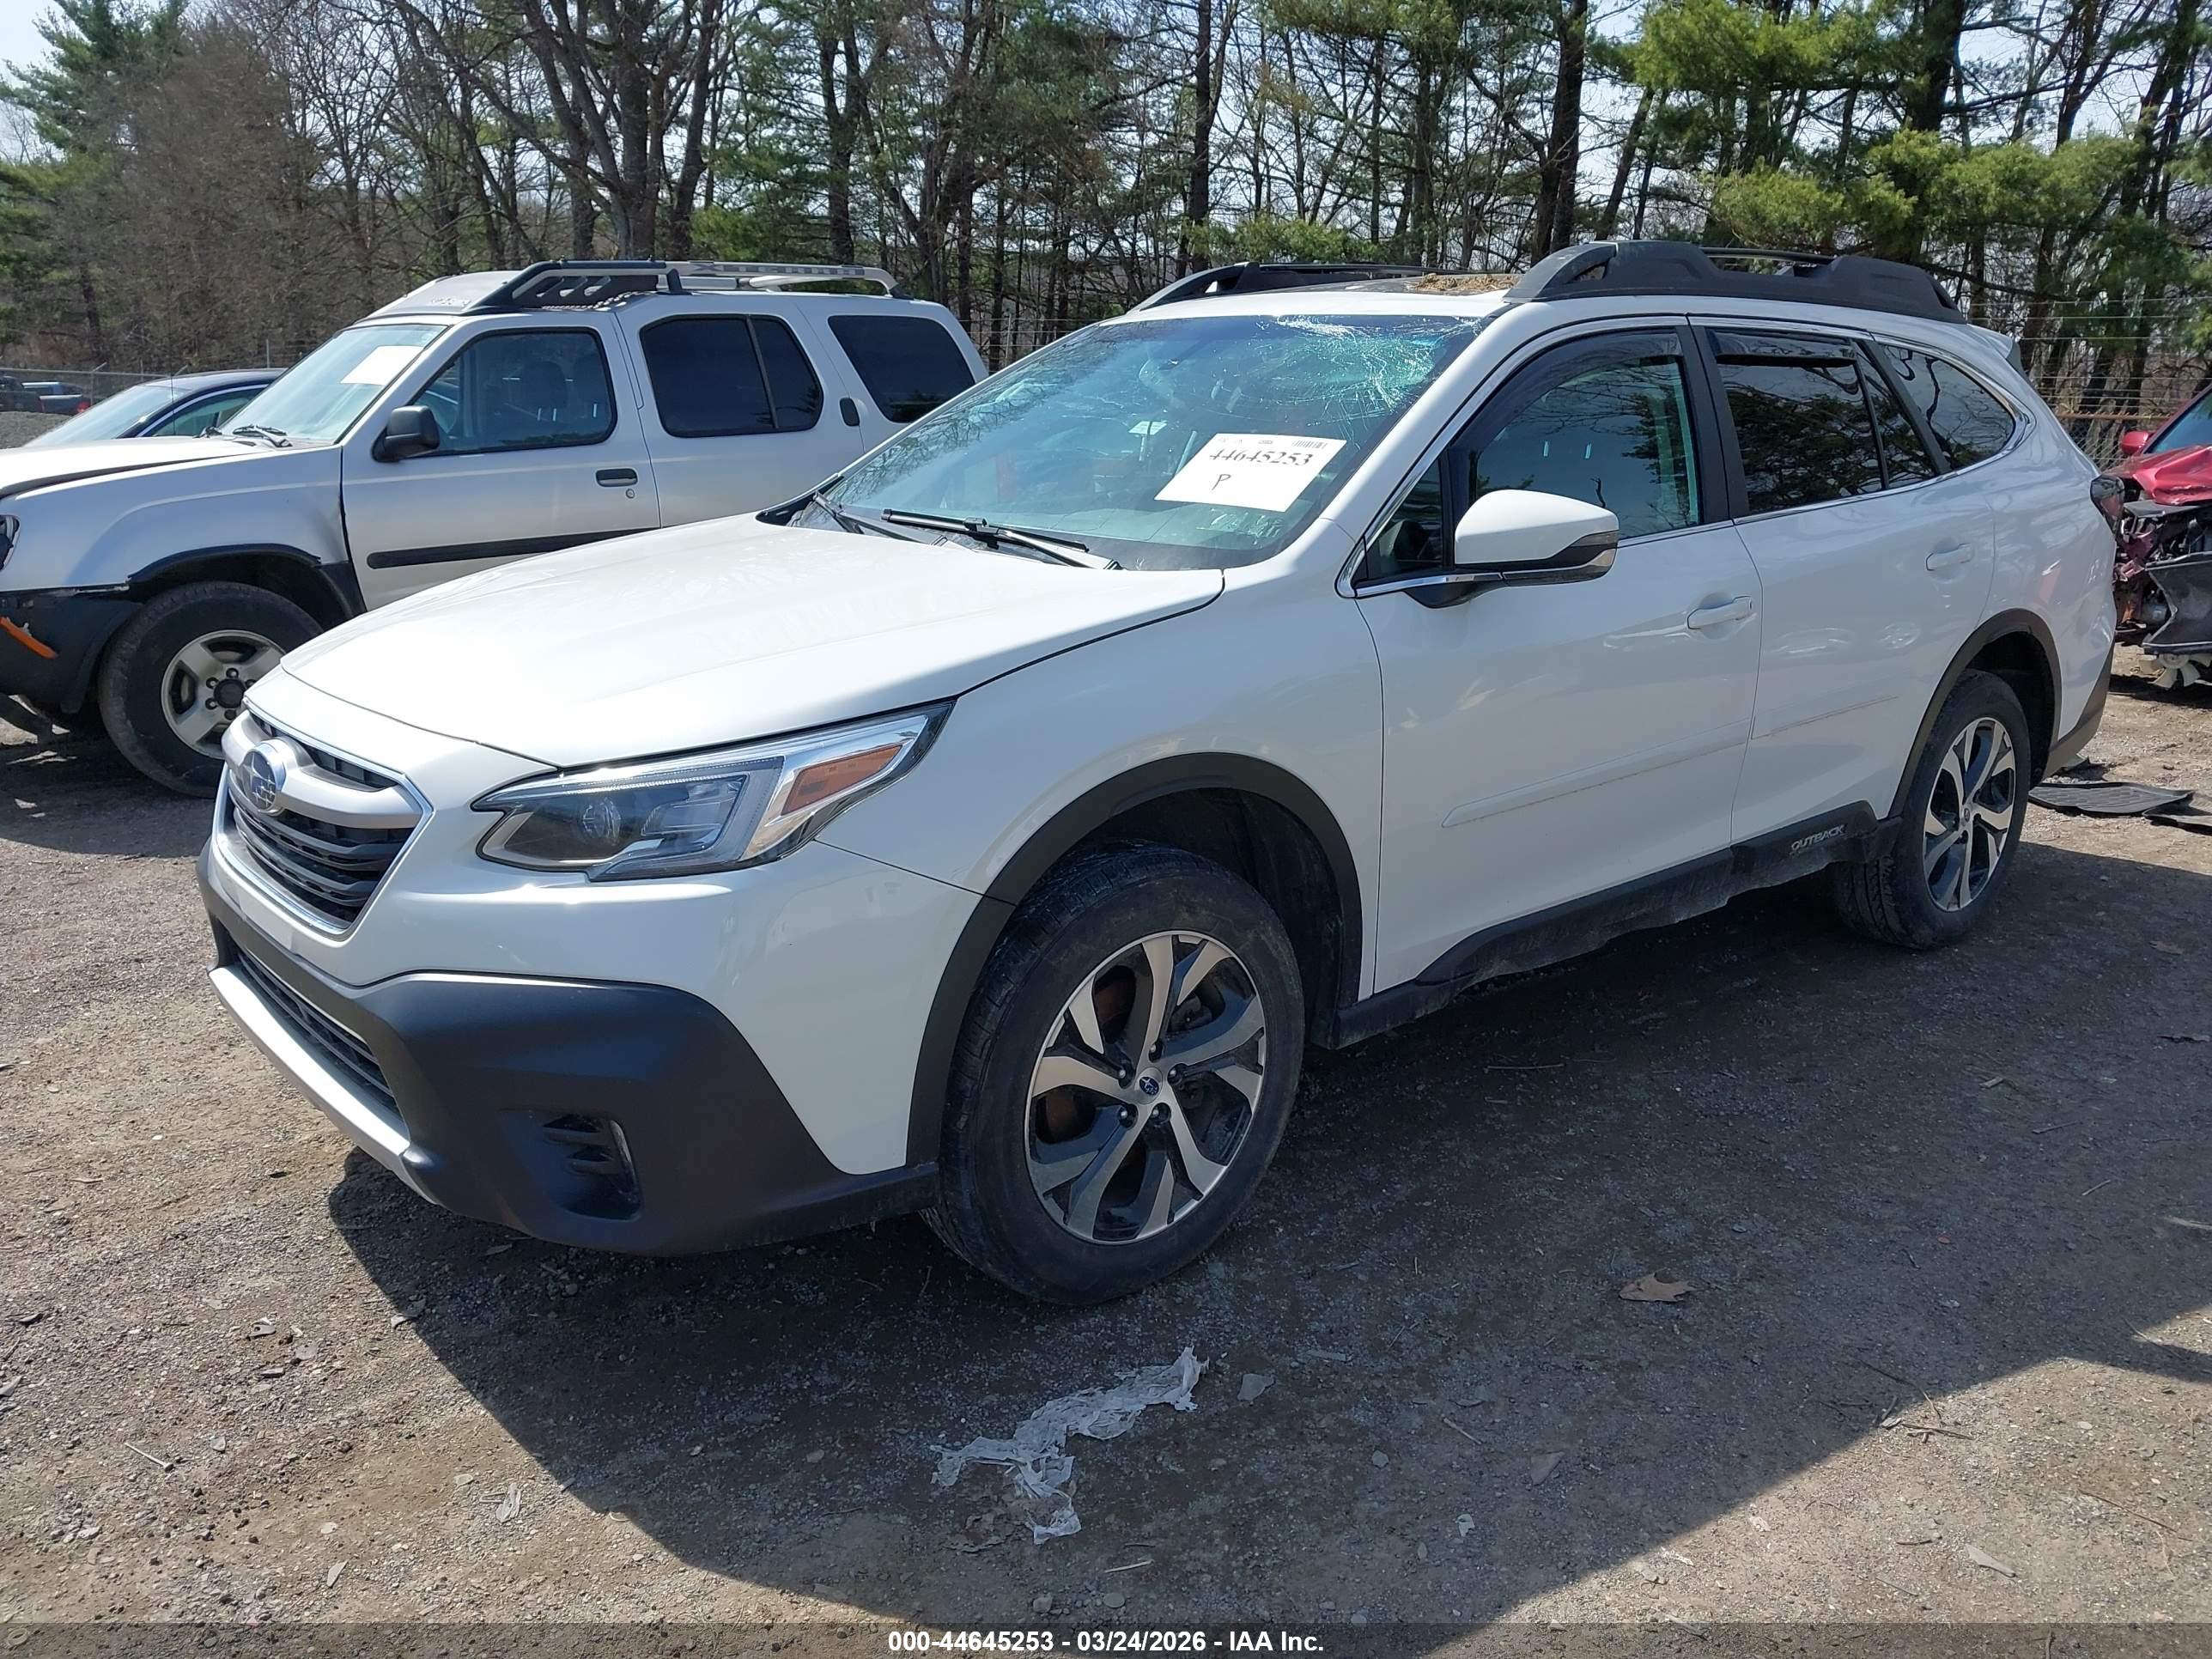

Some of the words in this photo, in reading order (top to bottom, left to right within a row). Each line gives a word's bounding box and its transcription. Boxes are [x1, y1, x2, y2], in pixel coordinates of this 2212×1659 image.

[1209, 448, 1314, 465] 44645253
[1211, 473, 1232, 490] P
[1790, 824, 1845, 851] OUTBACK
